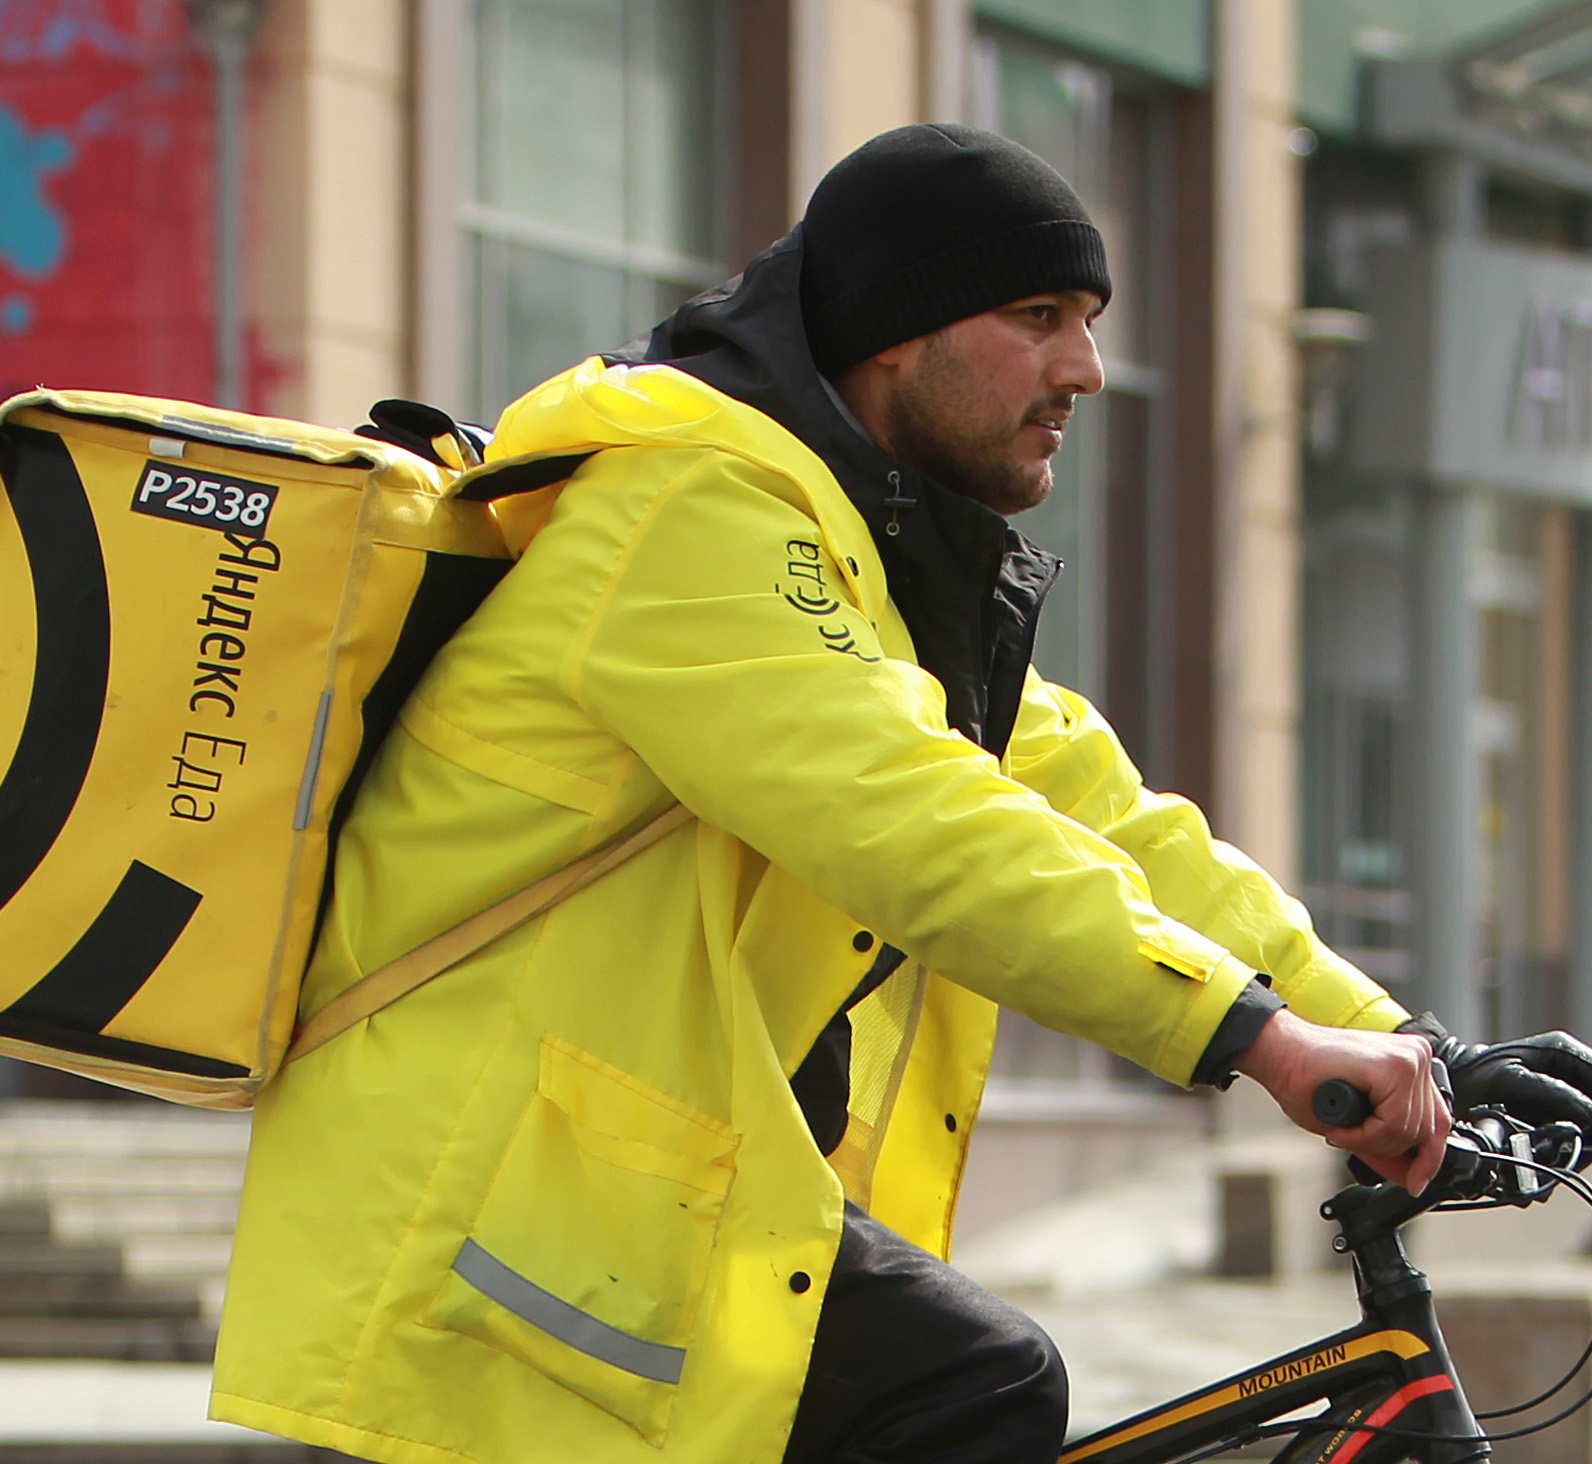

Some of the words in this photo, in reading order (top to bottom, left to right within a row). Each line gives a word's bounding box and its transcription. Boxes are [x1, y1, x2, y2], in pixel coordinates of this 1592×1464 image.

[139, 468, 270, 529] P2538
[189, 532, 281, 719] Яндекс
[167, 731, 247, 824] Еда
[1237, 1345, 1347, 1398] MOUNTAIN
[1324, 1408, 1363, 1455] WORDS
